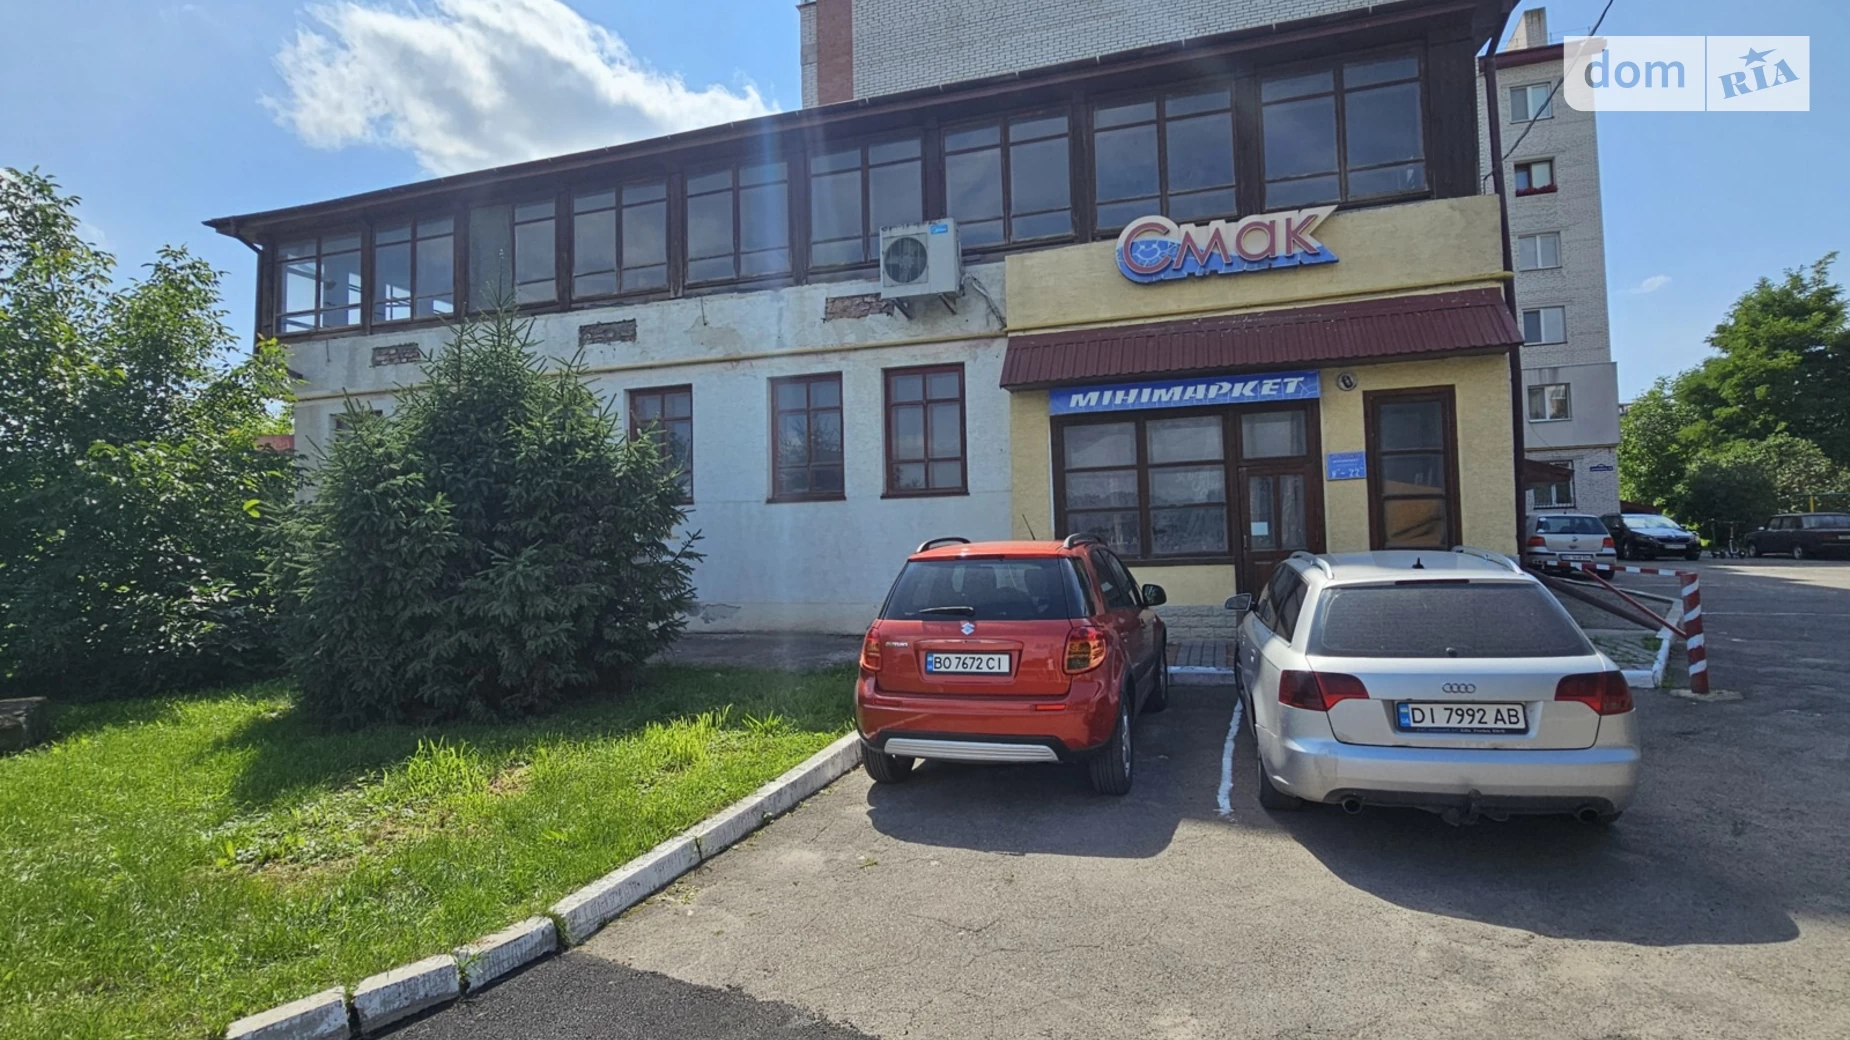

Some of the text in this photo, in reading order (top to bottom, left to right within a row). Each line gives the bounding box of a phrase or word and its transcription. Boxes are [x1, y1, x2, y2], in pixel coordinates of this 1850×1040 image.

[1123, 214, 1320, 274] Смак
[1069, 377, 1304, 408] МІНІМАРКЕТ
[933, 656, 952, 670] BO
[955, 656, 984, 670] 7672
[986, 657, 1001, 670] CI
[1411, 707, 1520, 725] DI 7992 AB
